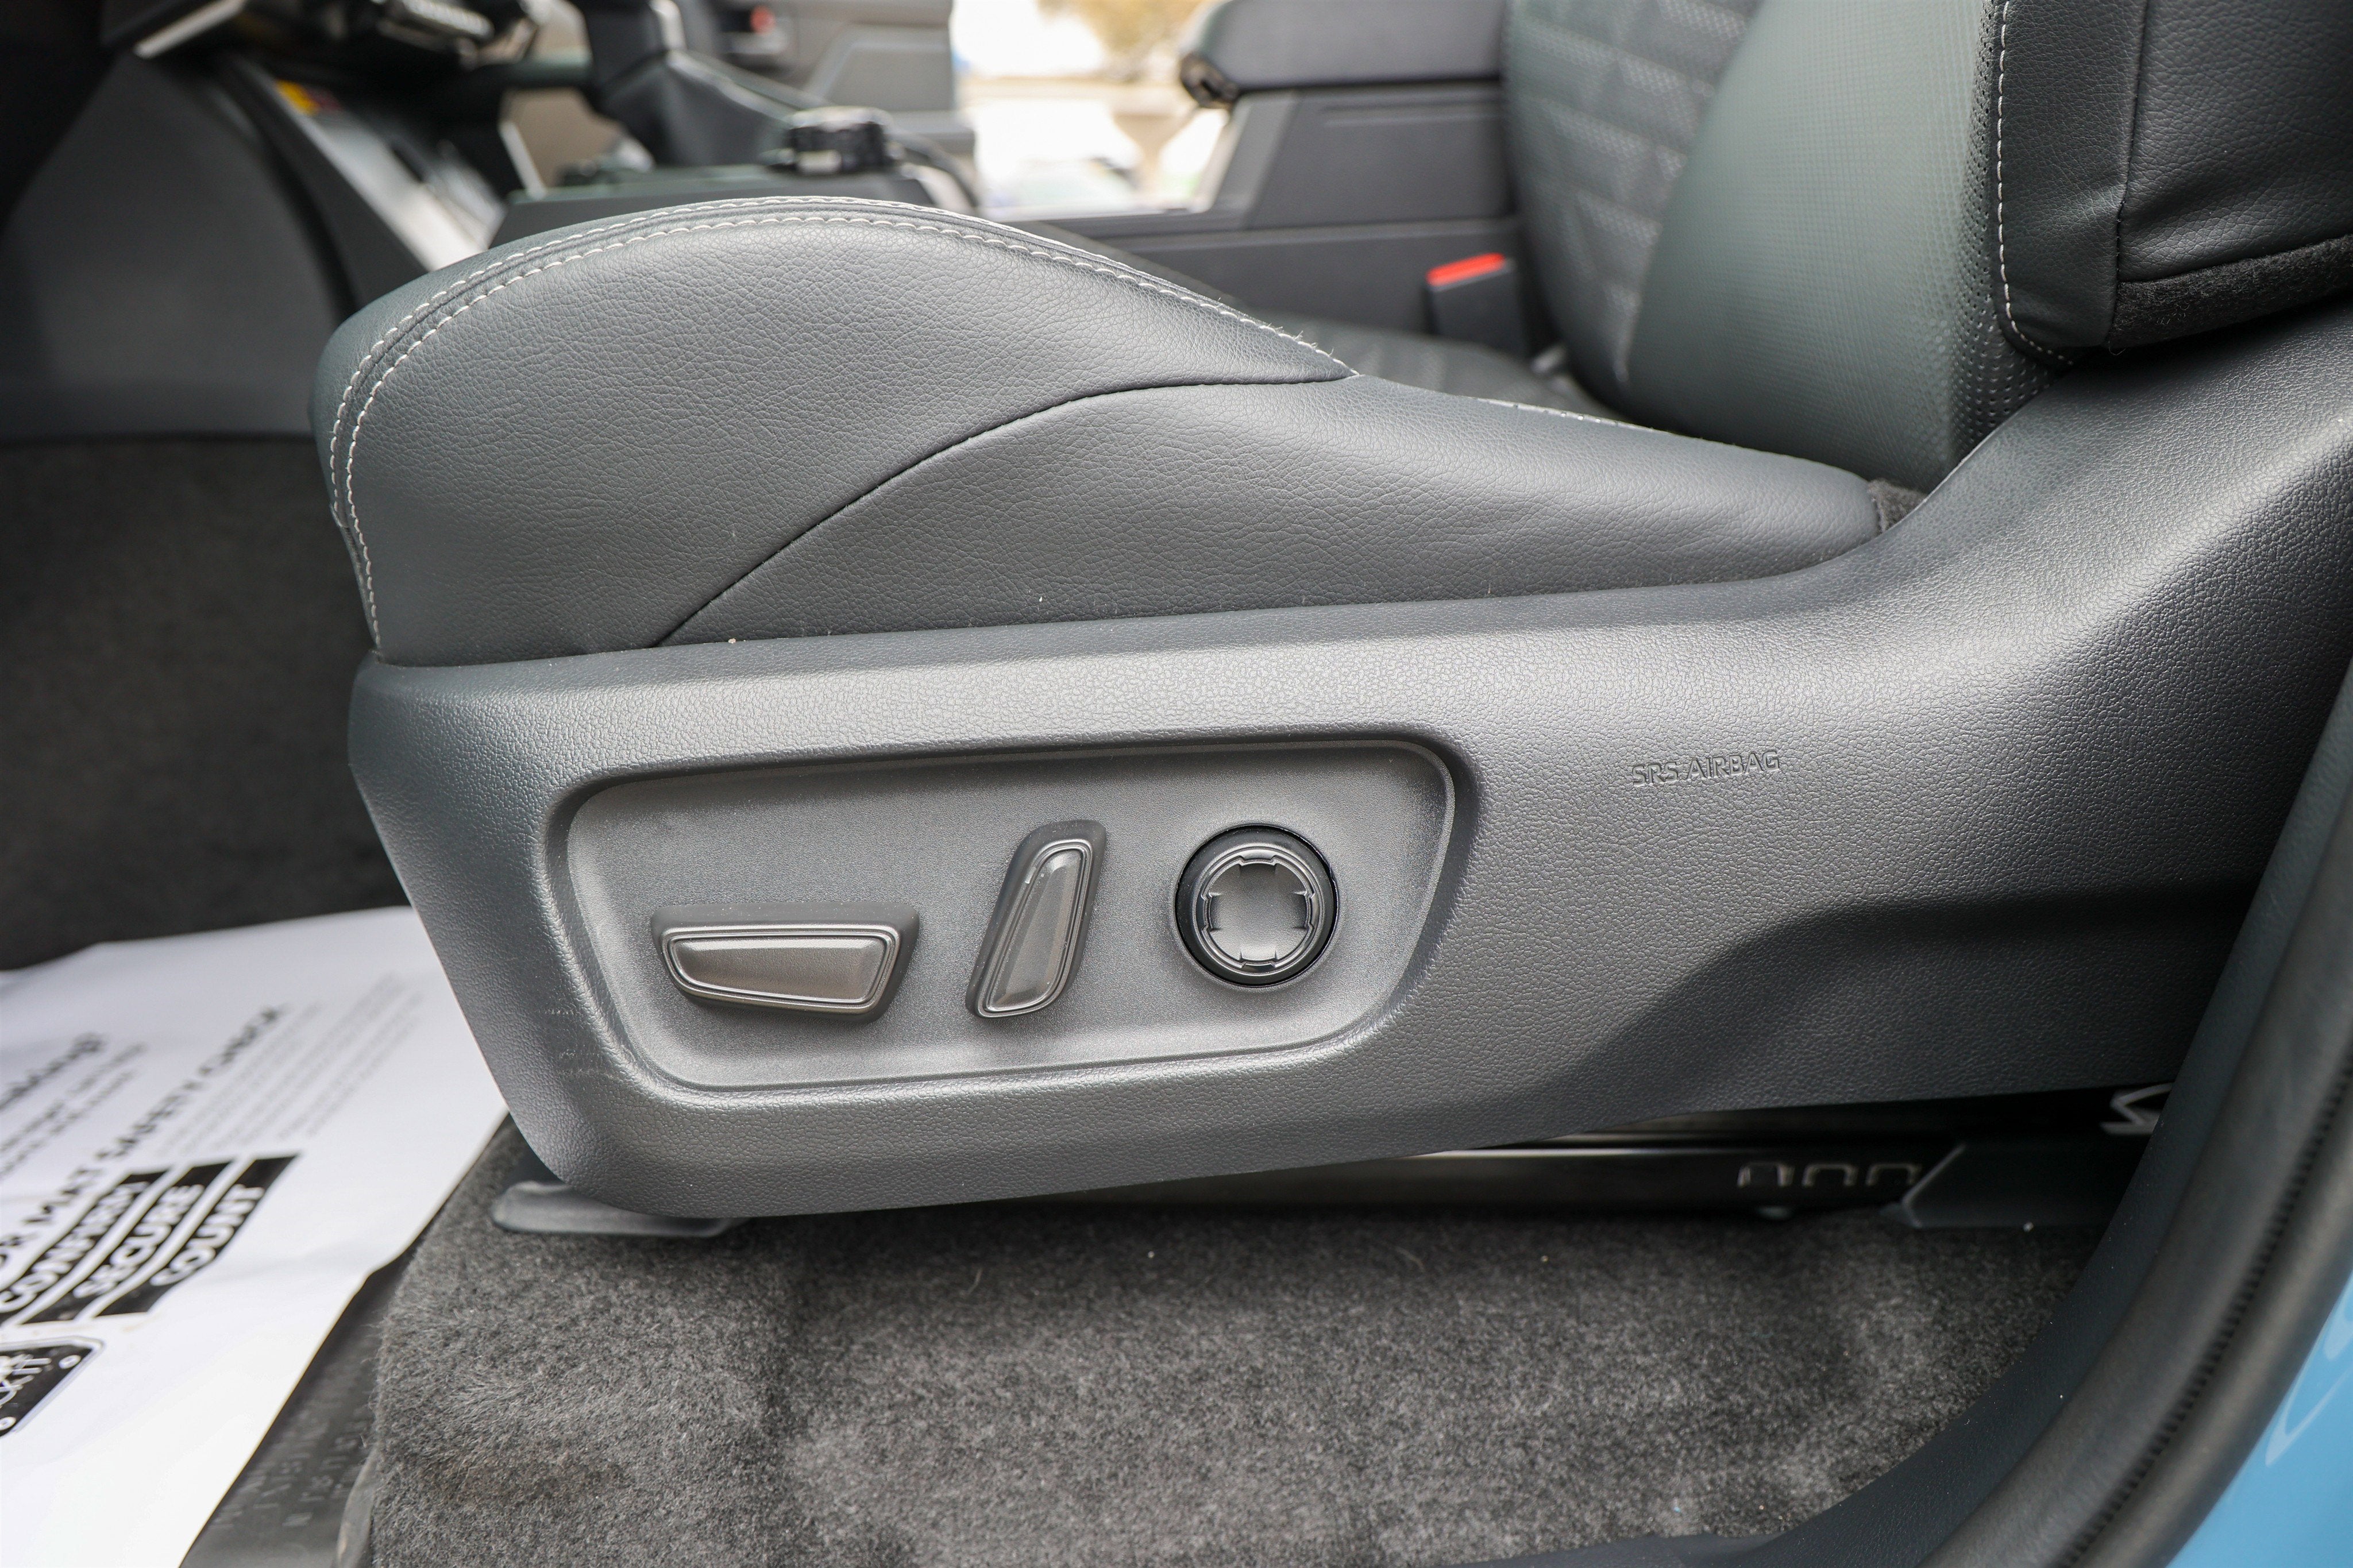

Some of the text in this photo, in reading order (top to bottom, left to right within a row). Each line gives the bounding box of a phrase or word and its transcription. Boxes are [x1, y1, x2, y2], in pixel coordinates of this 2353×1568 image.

[1631, 750, 1780, 786] SRS AIRBAG
[0, 1181, 151, 1312] CONFIRM
[72, 1183, 205, 1299] SECURE
[150, 1183, 265, 1285] COUNT
